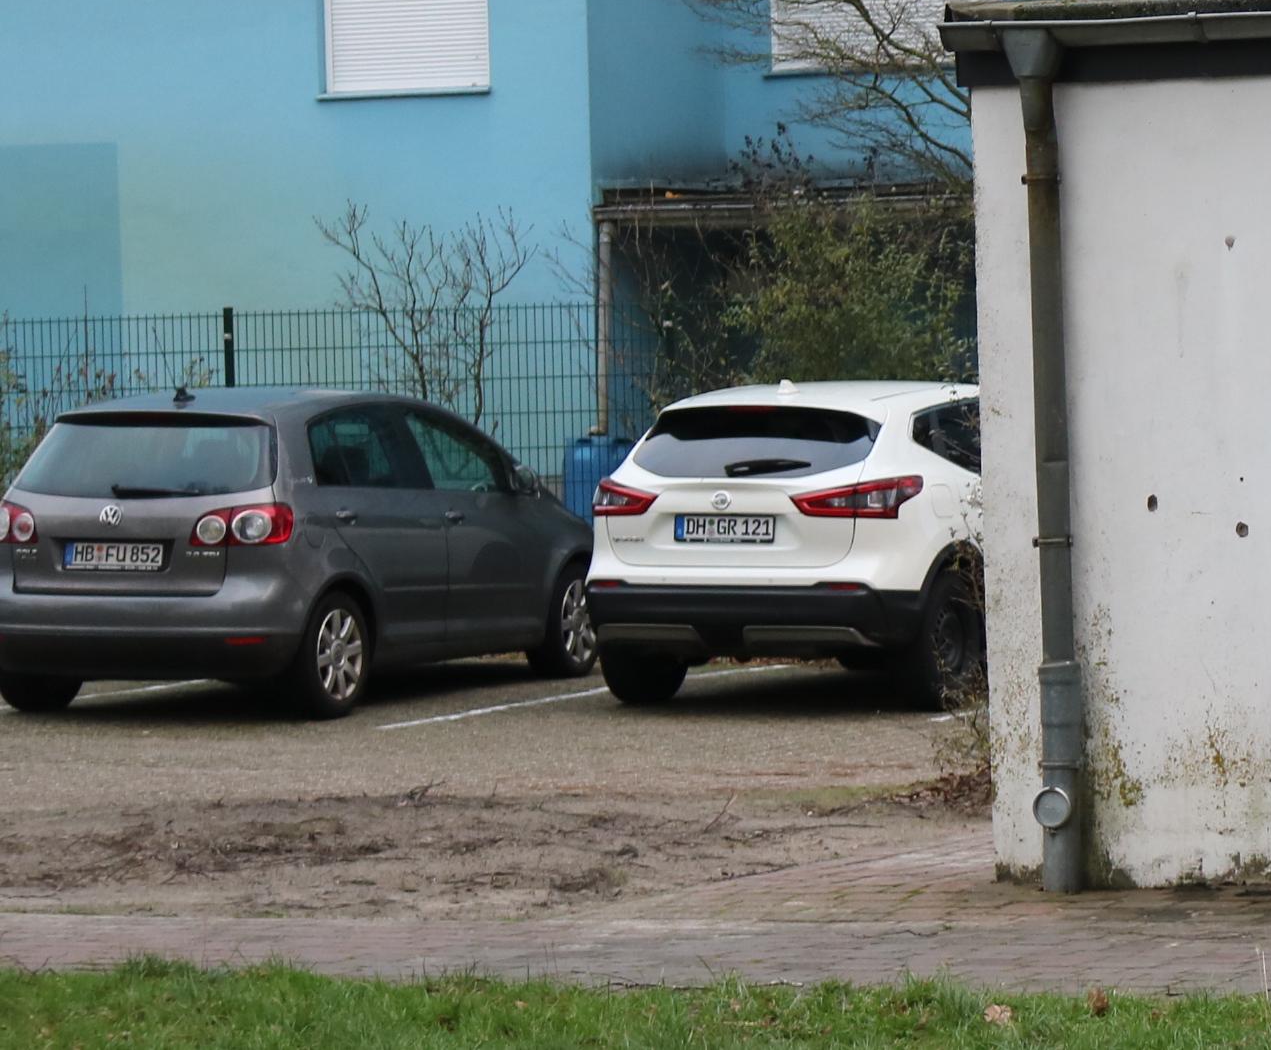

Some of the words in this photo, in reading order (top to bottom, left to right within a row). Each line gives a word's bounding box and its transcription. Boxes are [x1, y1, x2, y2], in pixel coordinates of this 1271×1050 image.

[685, 518, 706, 536] DH
[716, 518, 737, 536] GR
[740, 518, 771, 536] 121
[74, 544, 94, 562] HB
[105, 544, 127, 563] FU
[129, 543, 161, 564] 852
